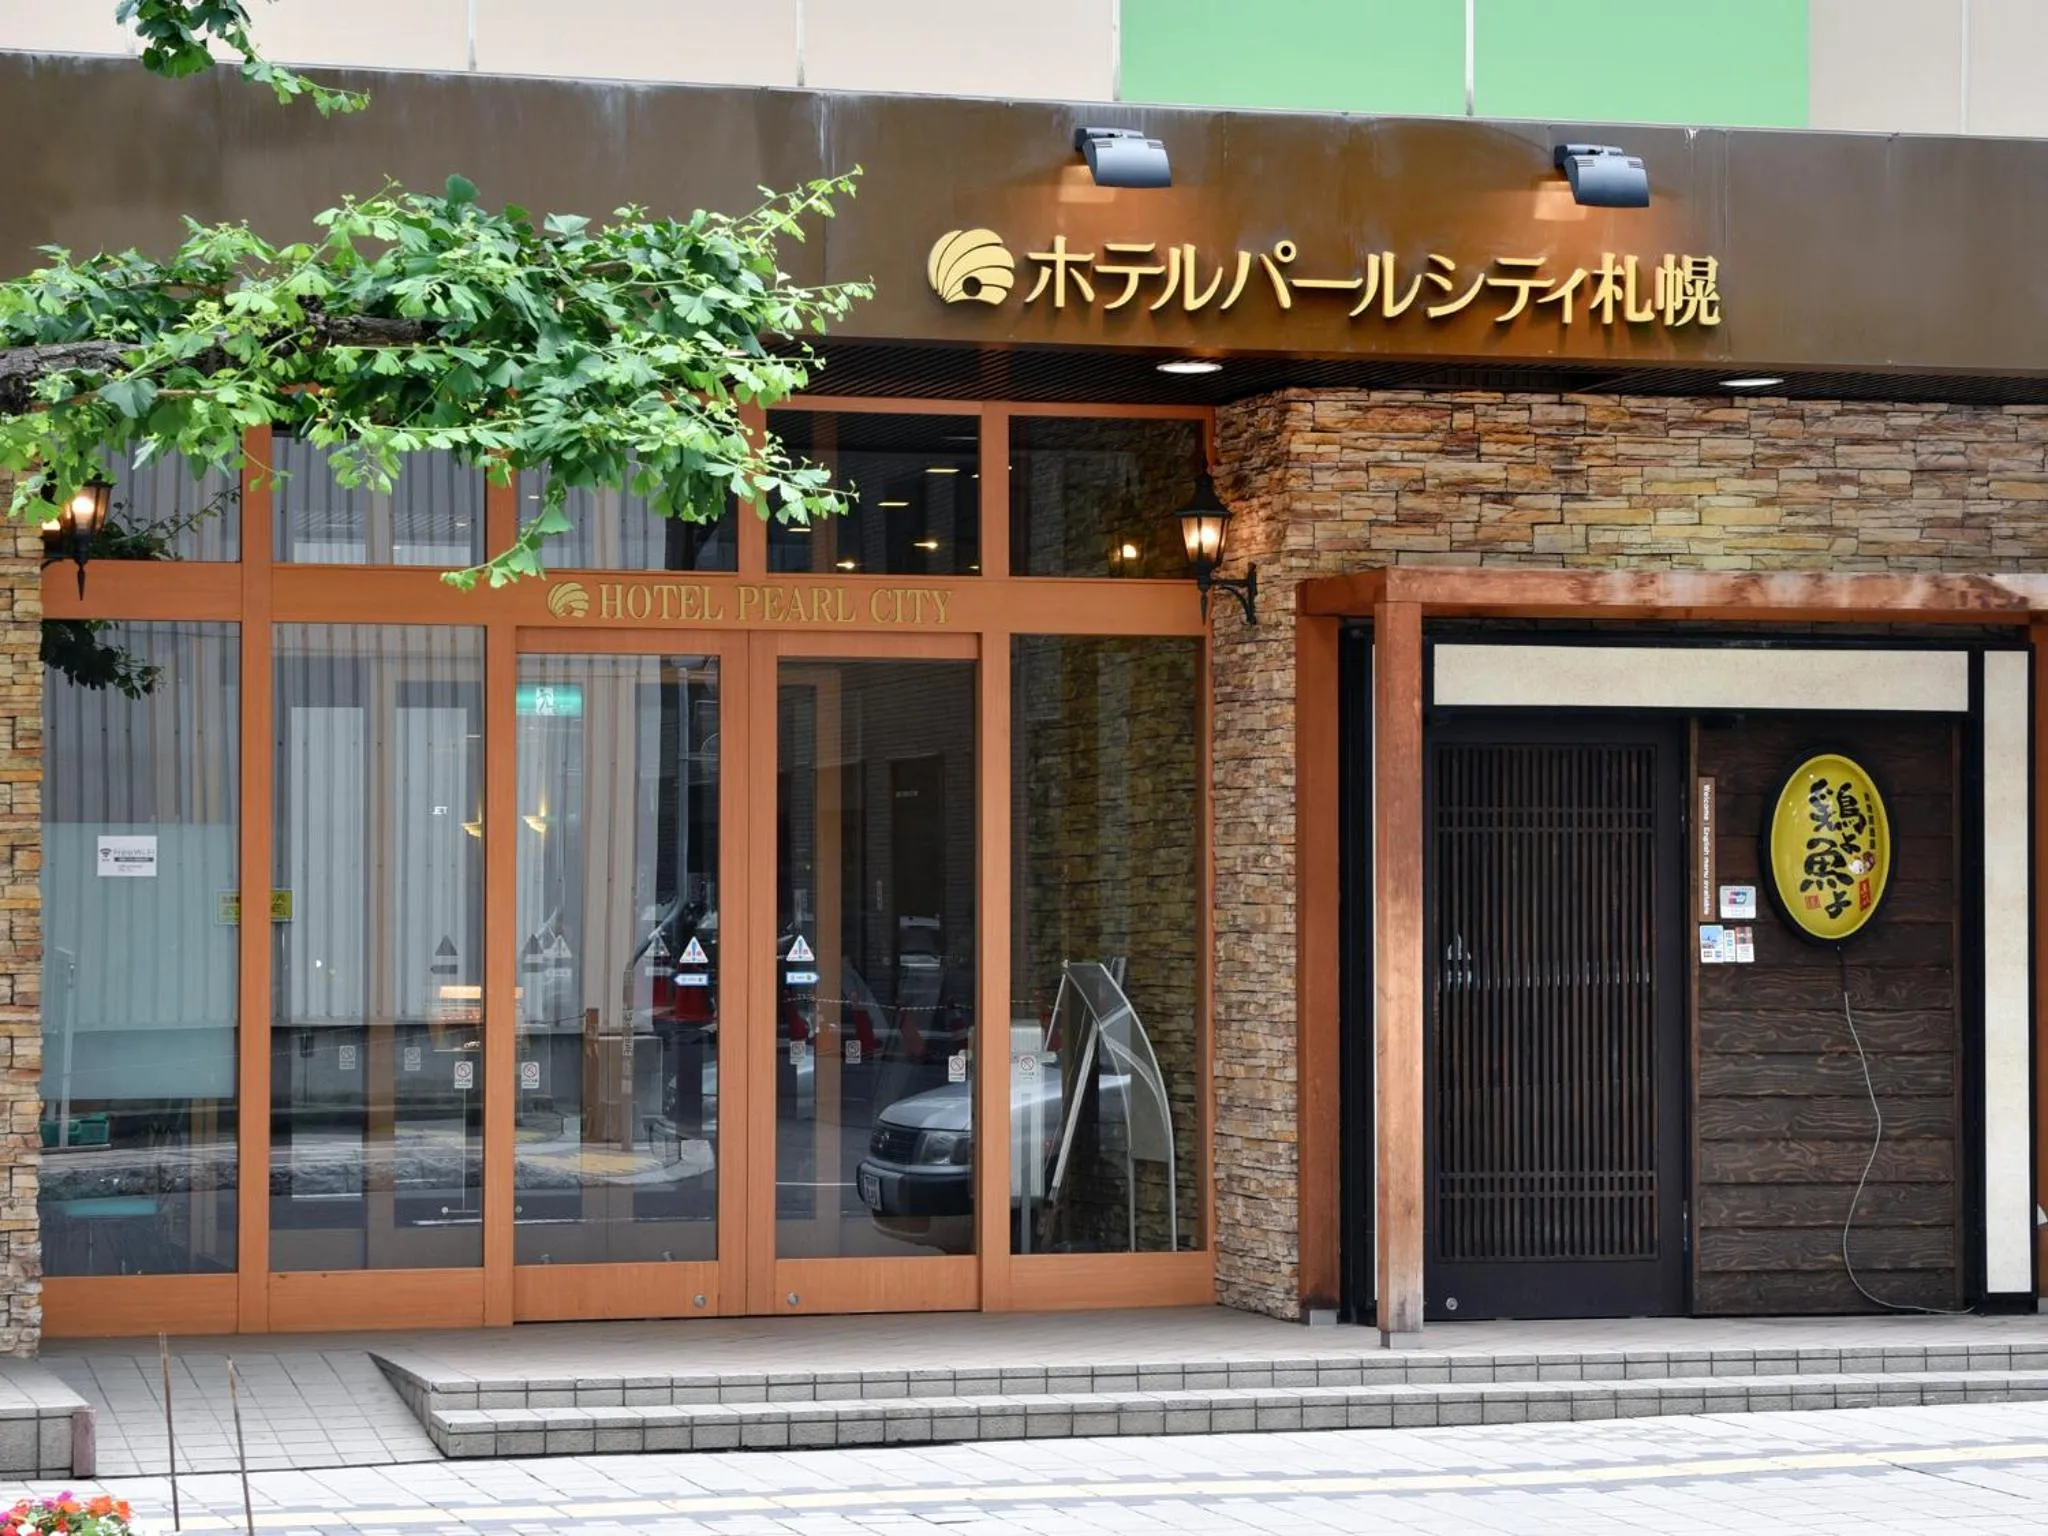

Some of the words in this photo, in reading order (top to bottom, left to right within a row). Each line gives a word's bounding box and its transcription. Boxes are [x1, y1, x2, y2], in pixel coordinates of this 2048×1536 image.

[1025, 235, 1722, 327] ホテルパールシティ札幌
[600, 583, 723, 620] HOTEL
[737, 586, 857, 623] PEARL
[870, 588, 954, 624] CITY
[1703, 784, 1711, 821] Welcome
[1702, 827, 1711, 856] English
[1703, 880, 1711, 916] available
